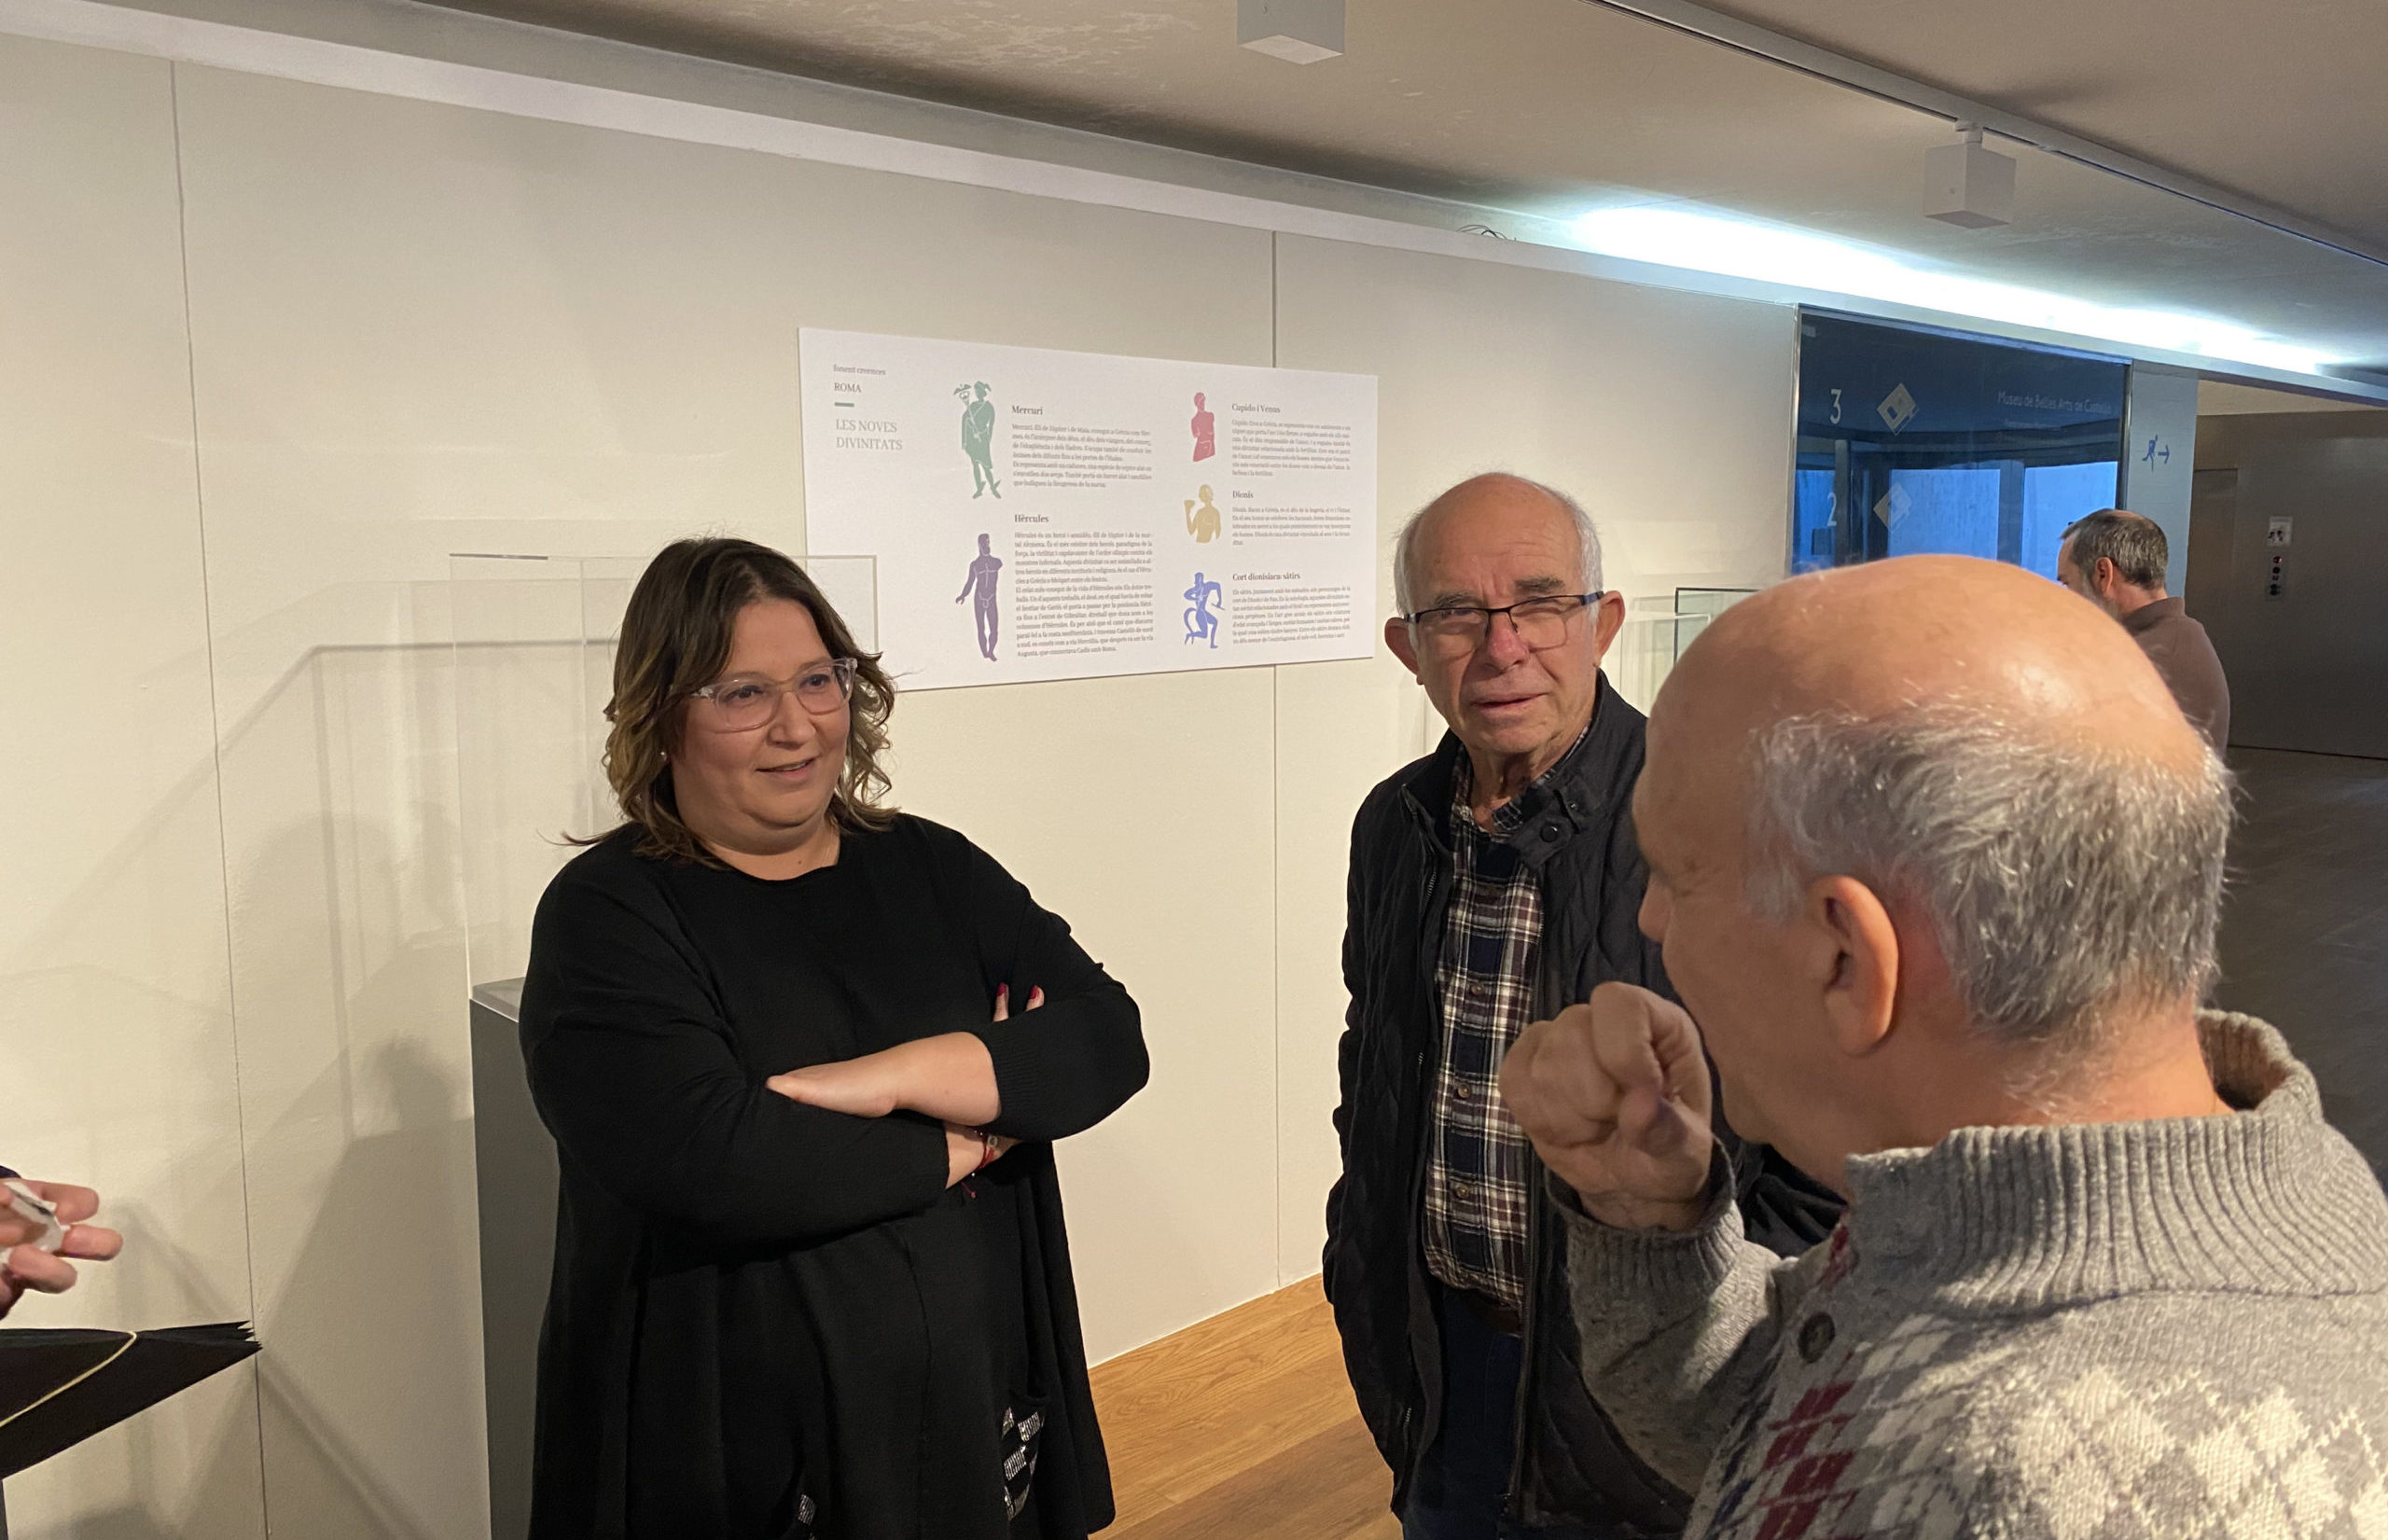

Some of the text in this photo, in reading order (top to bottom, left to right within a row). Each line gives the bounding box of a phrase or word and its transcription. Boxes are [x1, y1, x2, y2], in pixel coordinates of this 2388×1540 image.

[834, 382, 862, 393] ROMA
[1998, 390, 2022, 406] Museu
[1012, 405, 1043, 415] Mercuri
[1232, 403, 1256, 412] Cupido
[1260, 404, 1281, 413] Venus
[1830, 389, 1841, 424] 3
[836, 419, 897, 433] LES NOVES
[836, 437, 903, 451] DIVINITATS
[1827, 492, 1837, 526] 2
